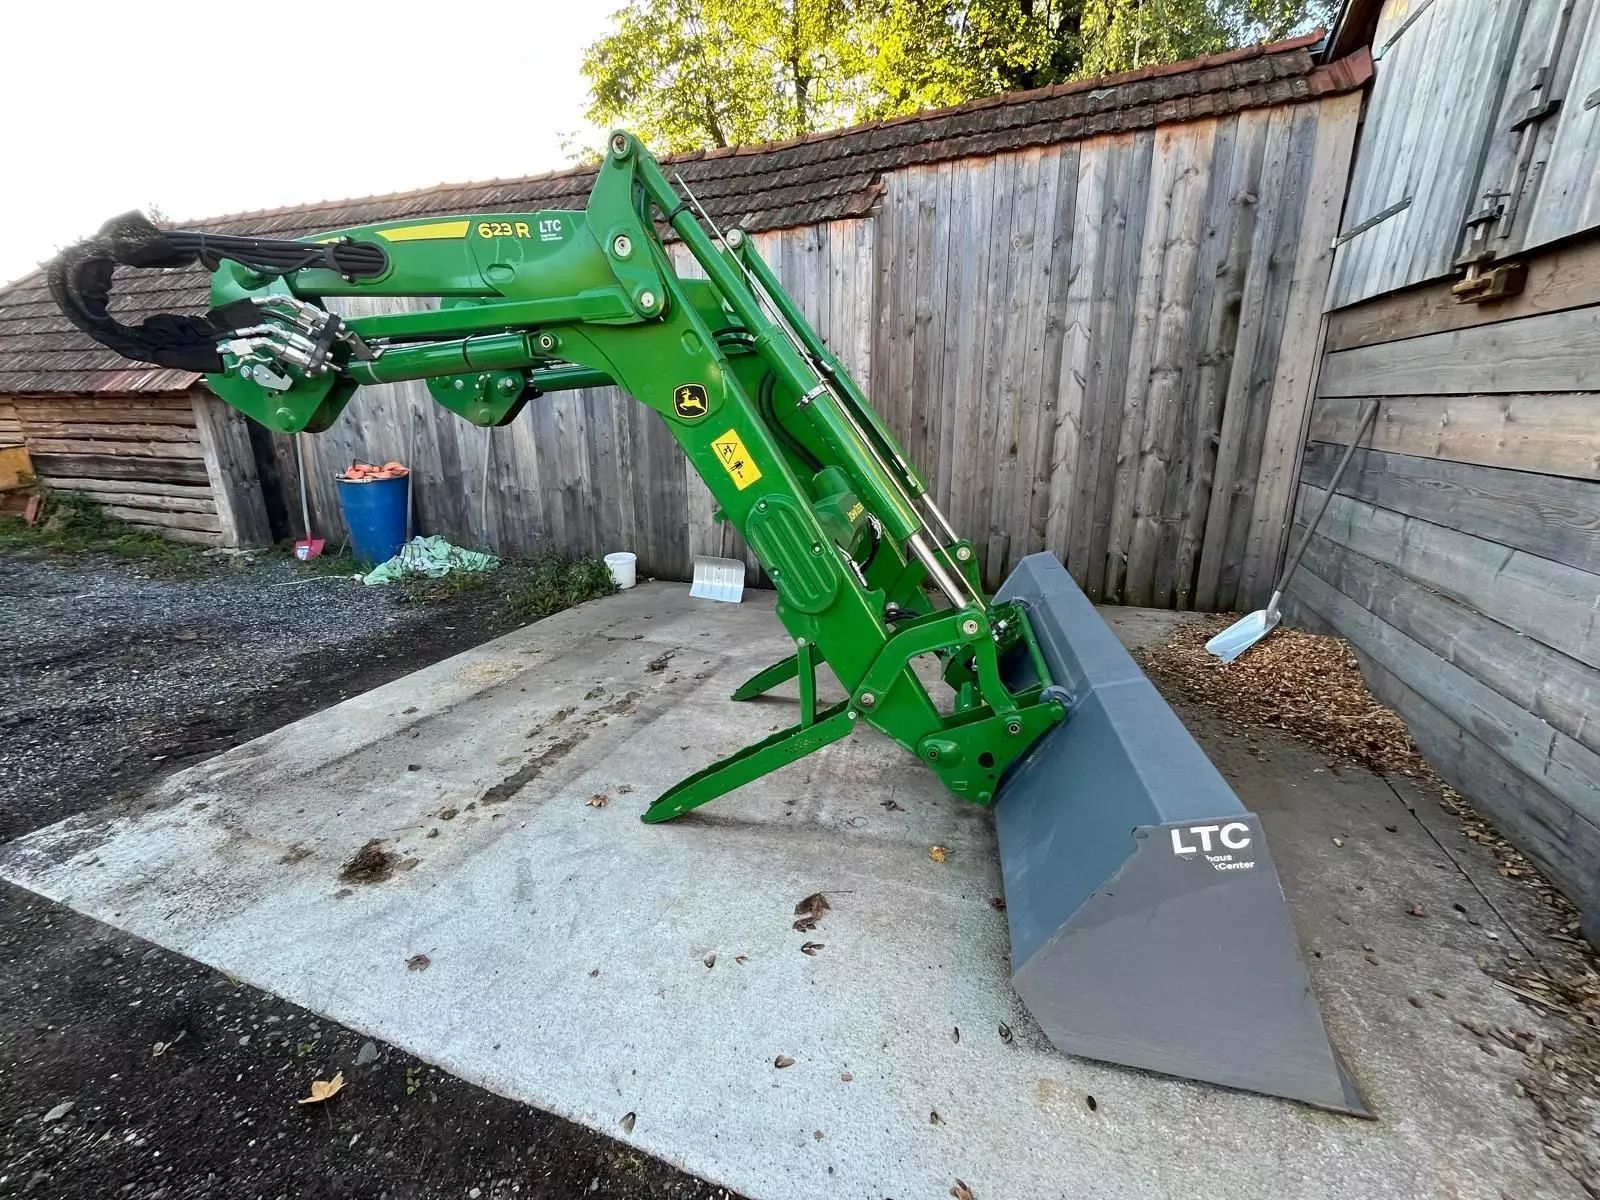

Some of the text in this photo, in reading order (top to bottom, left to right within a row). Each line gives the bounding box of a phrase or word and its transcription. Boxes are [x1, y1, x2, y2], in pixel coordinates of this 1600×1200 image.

[478, 222, 532, 239] 623 R
[539, 219, 561, 233] LTC
[1171, 822, 1250, 853] LTC
